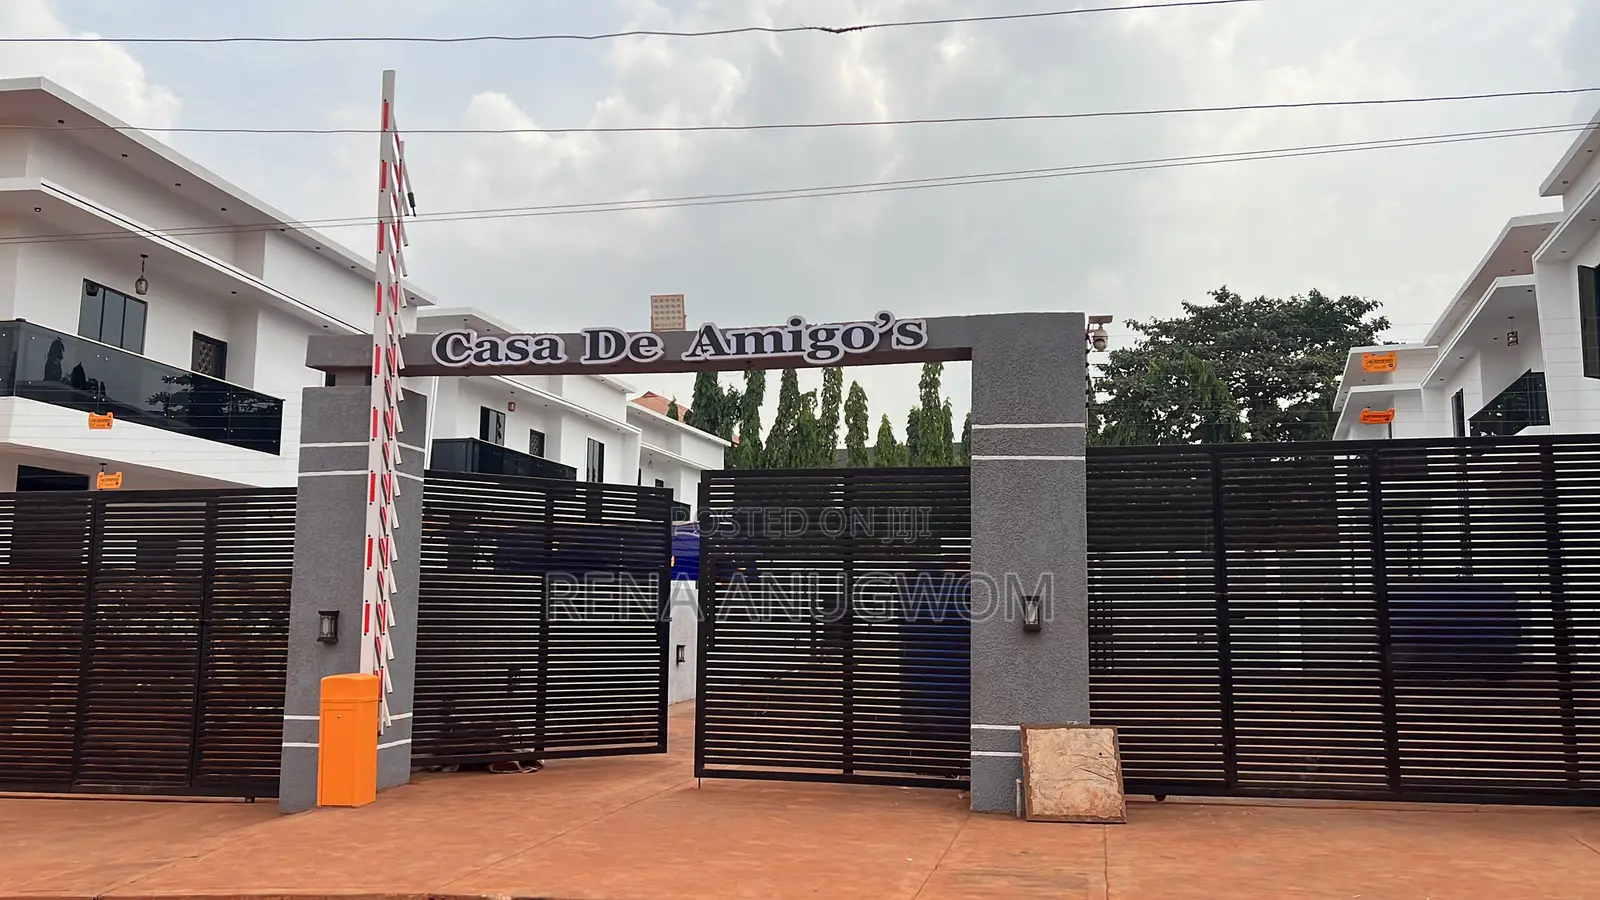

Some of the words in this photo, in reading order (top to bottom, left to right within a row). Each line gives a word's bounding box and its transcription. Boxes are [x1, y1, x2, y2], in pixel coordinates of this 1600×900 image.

[432, 329, 567, 367] Casa
[580, 326, 665, 364] De
[682, 311, 928, 364] Amigo's
